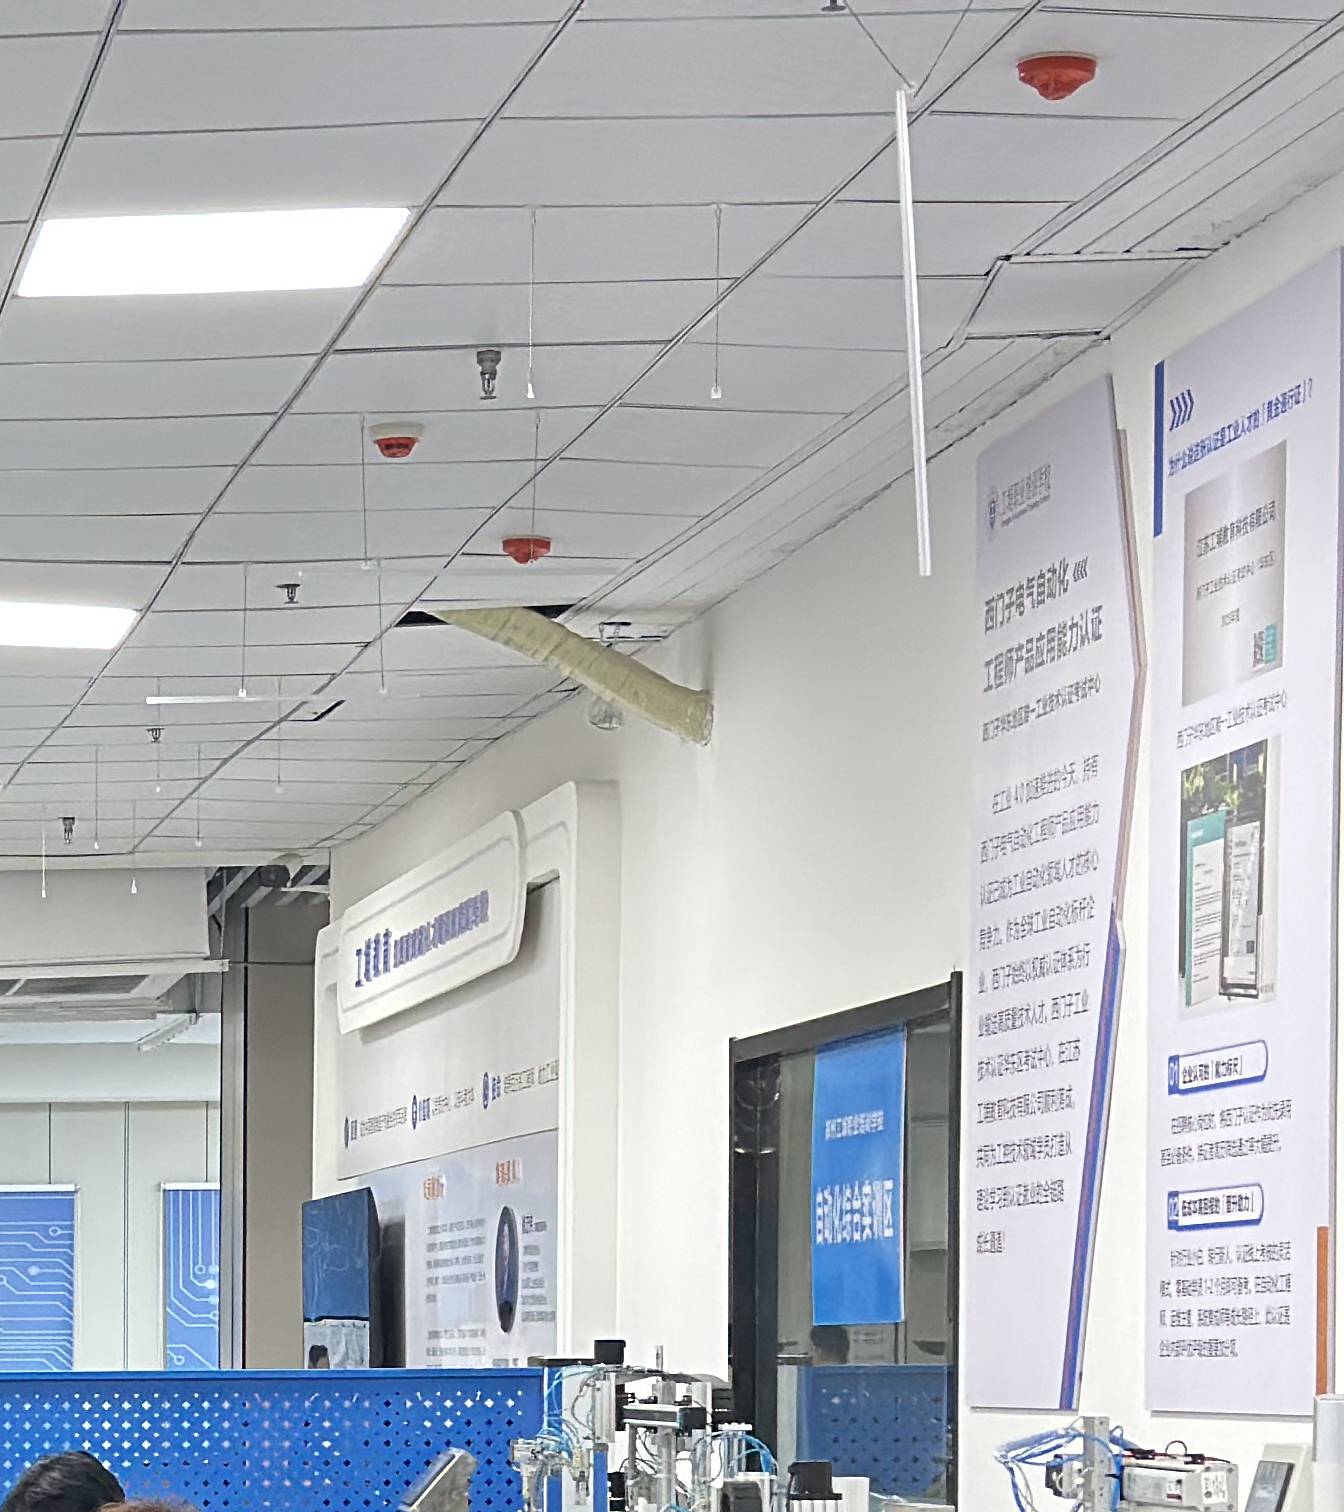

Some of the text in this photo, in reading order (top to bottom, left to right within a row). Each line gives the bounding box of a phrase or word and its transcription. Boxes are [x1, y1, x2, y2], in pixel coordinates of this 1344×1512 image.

[984, 555, 1069, 635] 西门子电气自动化
[983, 605, 1103, 694] 工程师产品应用能力认证
[815, 1179, 894, 1244] 自动化综合实训区
